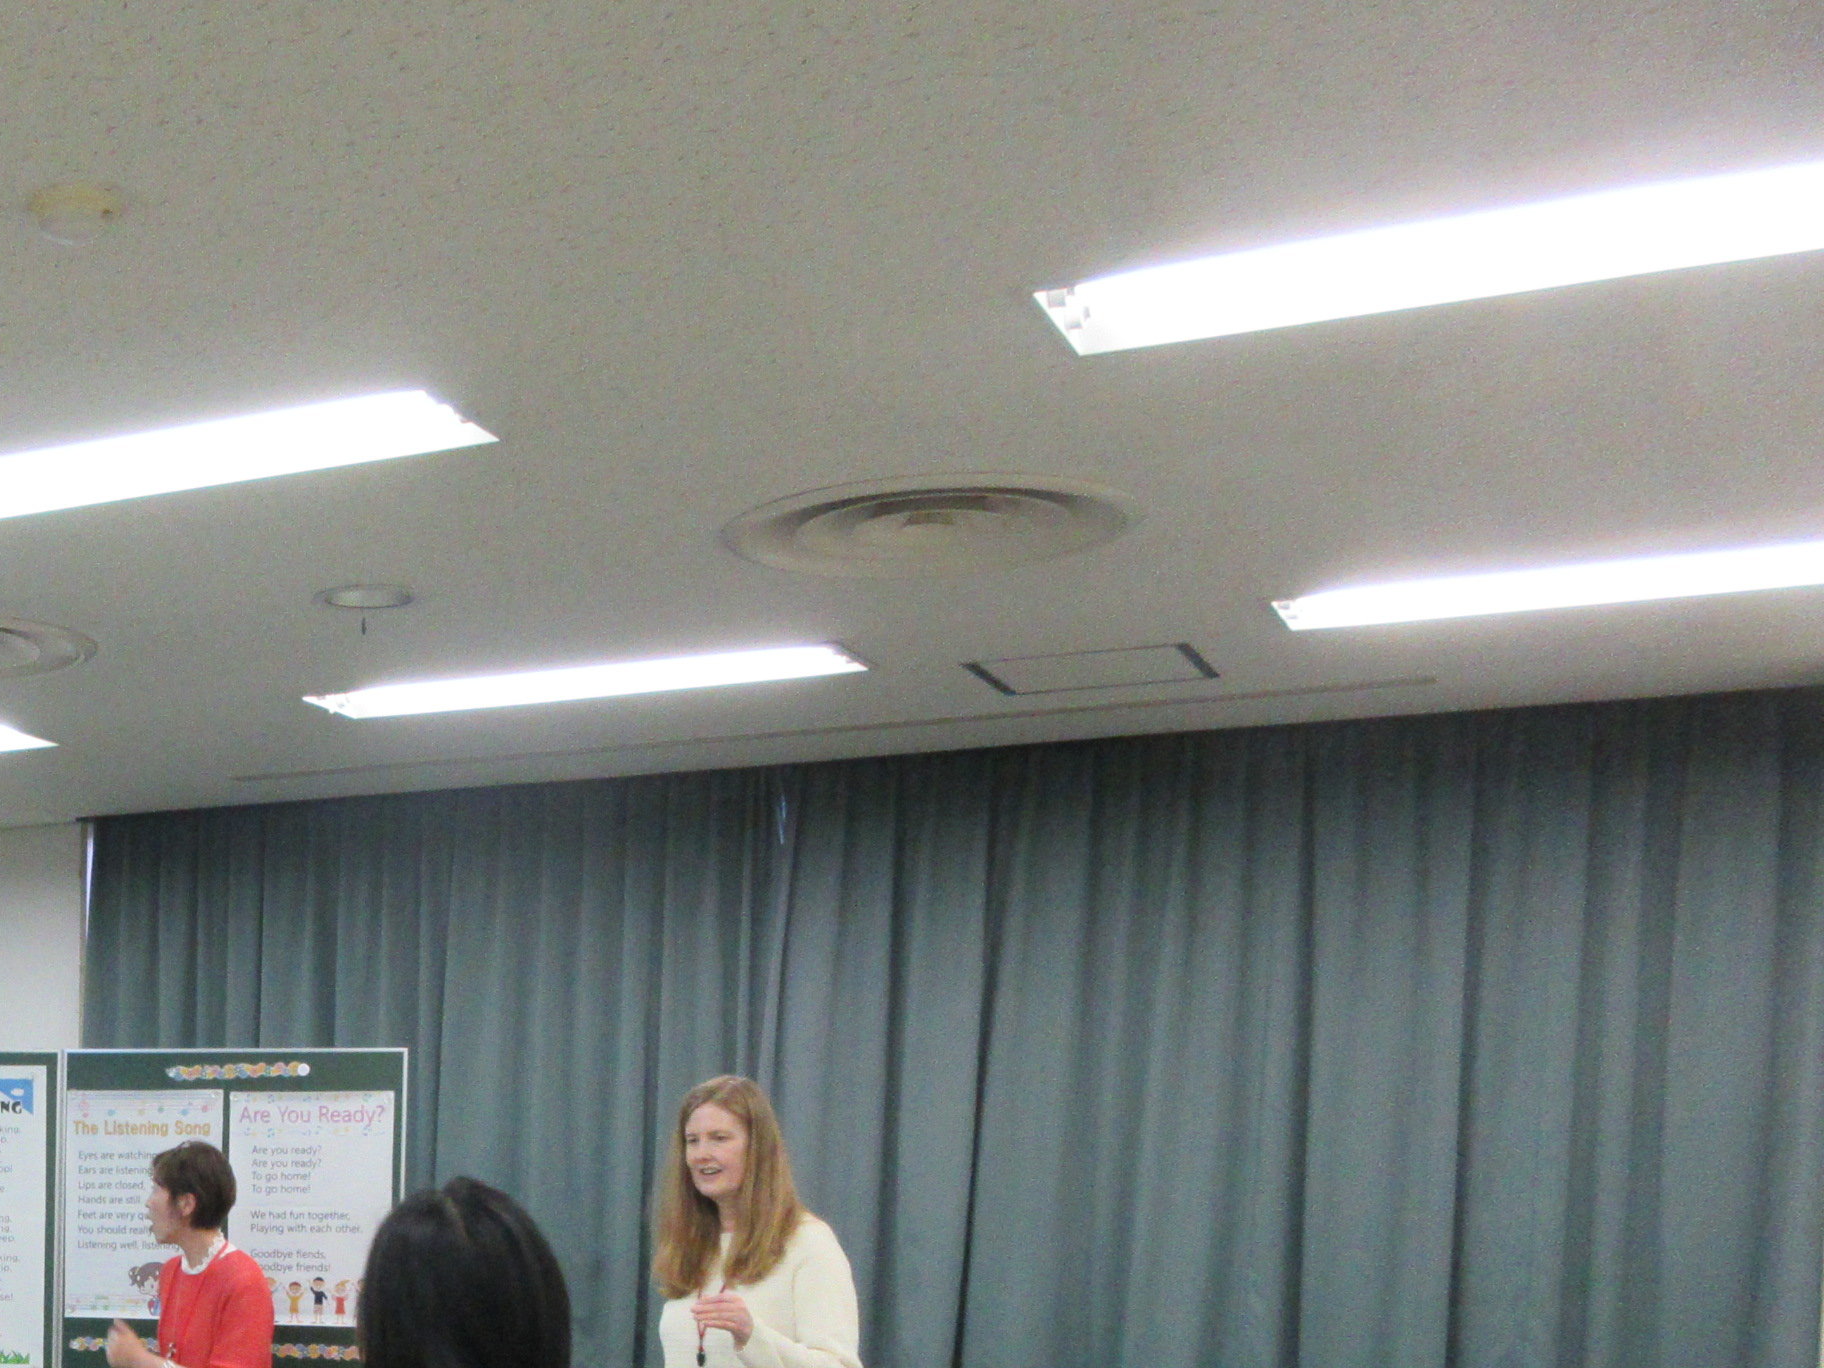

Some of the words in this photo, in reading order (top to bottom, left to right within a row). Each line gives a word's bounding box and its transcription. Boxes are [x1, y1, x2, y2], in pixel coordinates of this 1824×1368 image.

[239, 1106, 271, 1123] Are
[278, 1106, 311, 1124] You
[318, 1104, 385, 1127] Ready?
[73, 1120, 99, 1136] The
[104, 1120, 168, 1137] Listening
[174, 1121, 211, 1137] Song
[78, 1151, 98, 1161] Eyes
[100, 1152, 115, 1160] are
[252, 1145, 268, 1155] Are
[271, 1147, 288, 1156] you
[291, 1145, 322, 1156] ready?
[78, 1165, 97, 1175] Ears
[99, 1166, 114, 1175] are
[252, 1158, 268, 1168] Are
[271, 1160, 288, 1170] you
[291, 1158, 322, 1169] ready?
[252, 1171, 262, 1181] To
[265, 1173, 278, 1183] go
[280, 1171, 311, 1181] home!
[78, 1181, 95, 1191] Lips
[98, 1181, 113, 1190] are
[252, 1184, 262, 1193] To
[265, 1186, 278, 1196] go
[280, 1184, 311, 1193] home!
[78, 1195, 106, 1204] Hands
[77, 1210, 97, 1220] Feet
[99, 1212, 114, 1220] are
[116, 1212, 135, 1222] very
[250, 1210, 267, 1220] We
[268, 1210, 287, 1220] had
[289, 1210, 305, 1220] fun
[77, 1225, 94, 1234] You
[96, 1225, 127, 1235] should
[250, 1223, 284, 1235] Playing
[287, 1223, 307, 1233] with
[310, 1223, 332, 1233] each
[77, 1240, 117, 1251] Listening
[250, 1249, 293, 1261] Goodbye
[259, 1262, 293, 1274] oodbye
[296, 1262, 331, 1272] friends!
